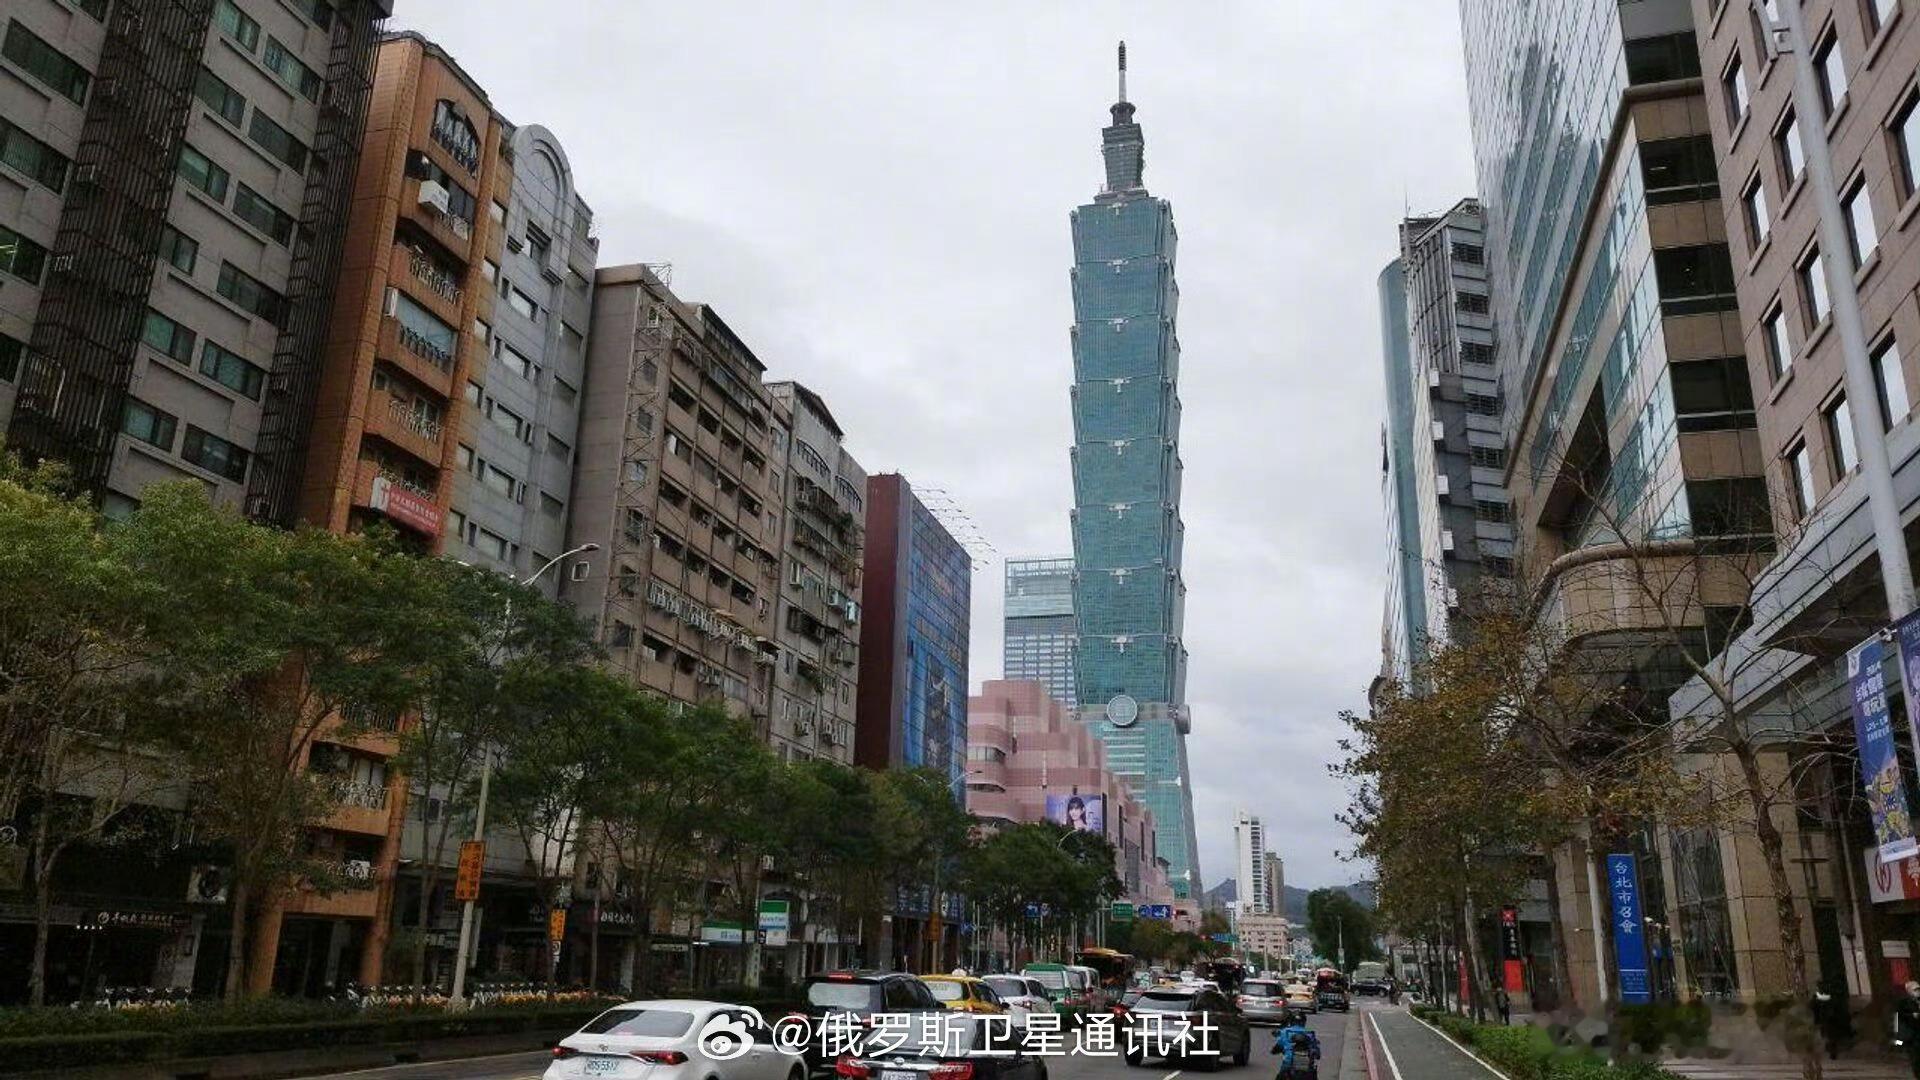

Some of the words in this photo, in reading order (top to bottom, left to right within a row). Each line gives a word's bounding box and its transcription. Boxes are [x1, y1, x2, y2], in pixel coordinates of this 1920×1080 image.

[1615, 862, 1638, 935] 台北市召會
